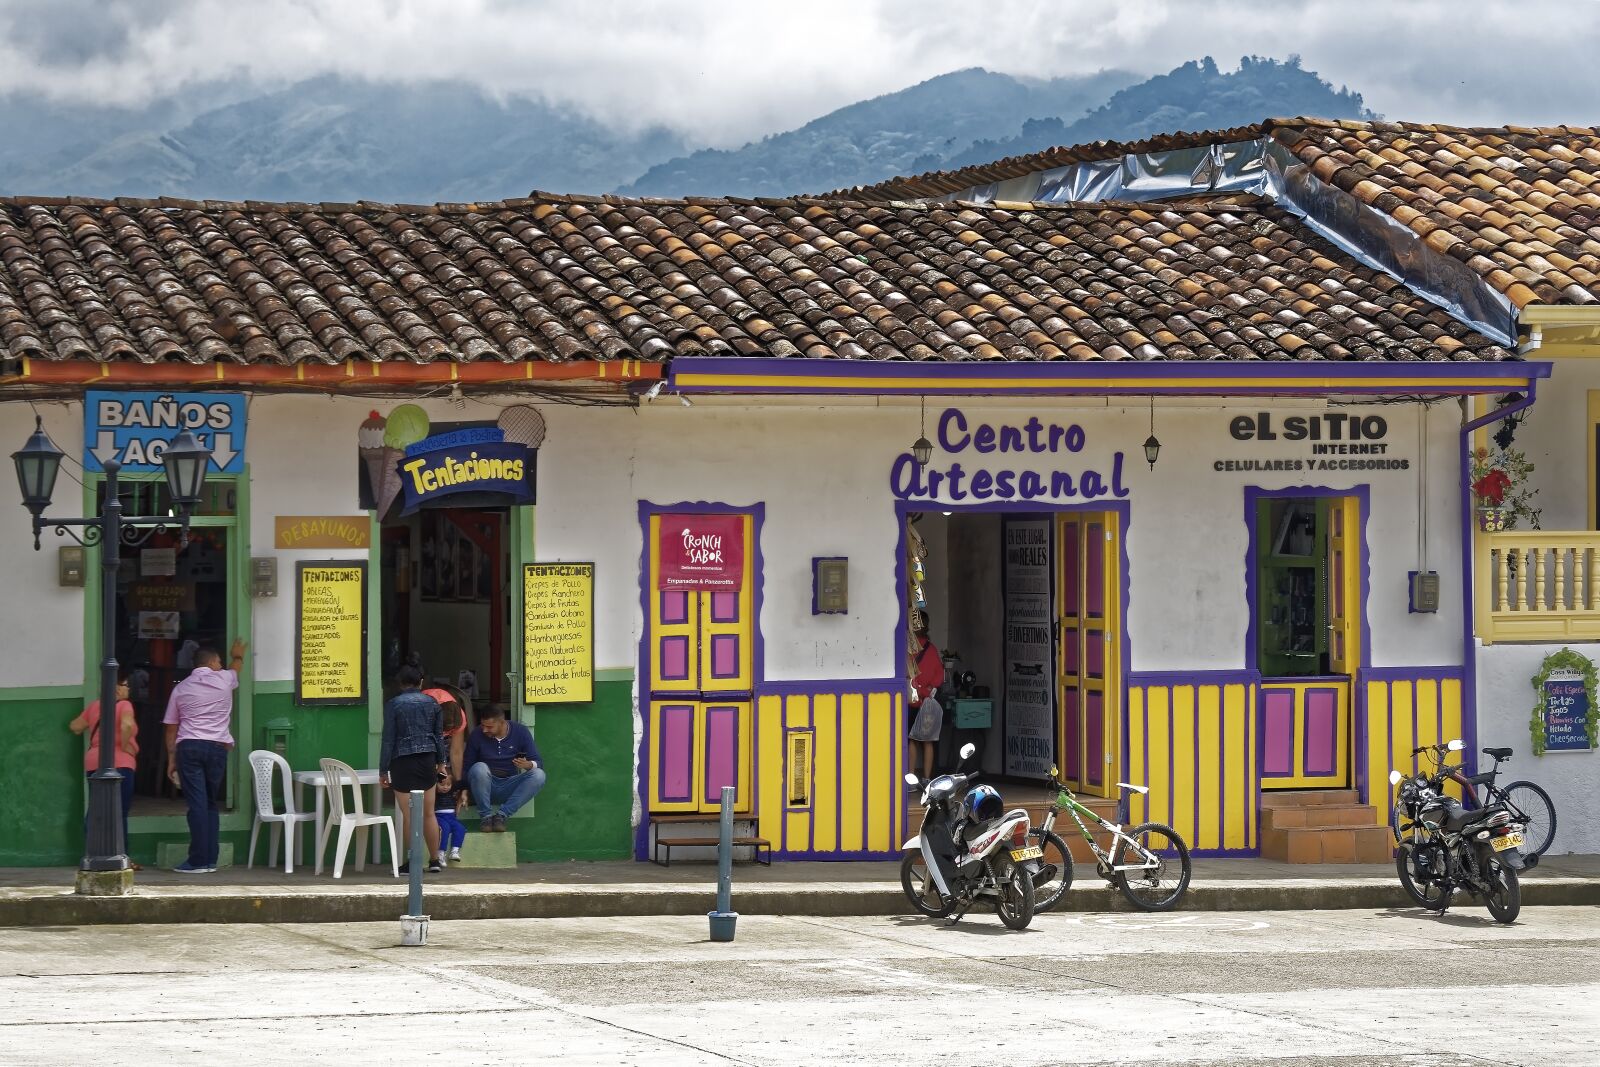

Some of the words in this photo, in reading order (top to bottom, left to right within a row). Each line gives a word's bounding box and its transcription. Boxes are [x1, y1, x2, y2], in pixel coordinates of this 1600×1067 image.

[98, 395, 232, 429] BAÑOS
[938, 408, 1085, 453] Centro
[1312, 443, 1388, 455] INTERNET
[403, 452, 523, 494] Tentaciones
[1213, 459, 1303, 472] CELULARES
[1306, 459, 1317, 471] Y
[1317, 459, 1410, 471] ACCESORIOS
[890, 452, 1130, 500] Artesanal
[281, 517, 366, 546] DESAYUNOS
[690, 549, 723, 564] SABOR
[1020, 547, 1047, 566] REALES
[304, 570, 360, 582] TENTACIONES
[527, 566, 591, 577] TENTACIONES
[530, 632, 582, 645] Hamburguesas
[1013, 627, 1048, 644] DIVERTIMOS
[1549, 696, 1575, 706] Tortas
[1548, 705, 1569, 716] Jugos
